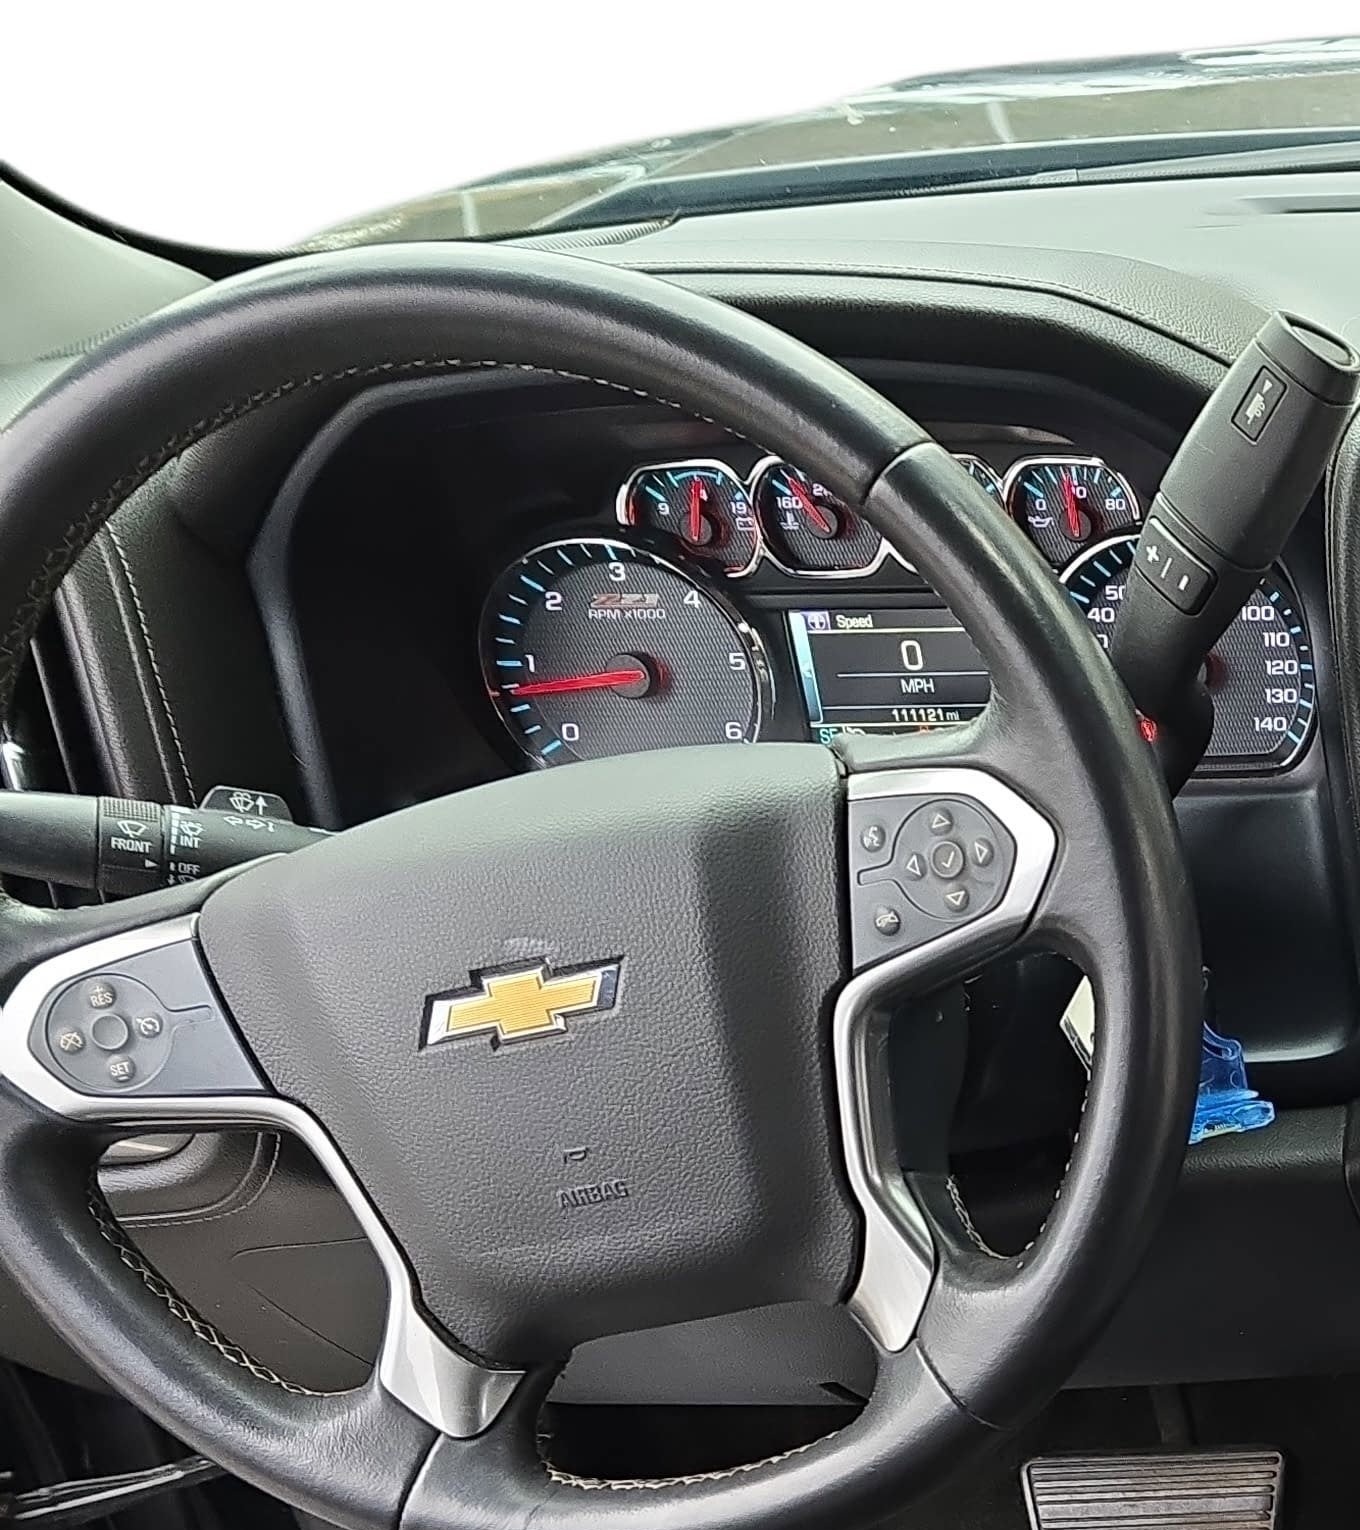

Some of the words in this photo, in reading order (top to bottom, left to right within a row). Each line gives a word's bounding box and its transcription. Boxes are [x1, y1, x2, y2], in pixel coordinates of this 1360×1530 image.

[658, 503, 670, 515] 9
[731, 501, 747, 514] 19
[777, 496, 803, 510] 160
[1035, 498, 1047, 511] 0
[1105, 499, 1126, 511] 80
[609, 562, 626, 582] 3
[545, 591, 562, 611] 2
[683, 590, 701, 609] 4
[588, 608, 621, 620] RPM
[1088, 607, 1115, 623] 40
[1242, 605, 1275, 621] 100
[835, 614, 873, 629] Speed
[1263, 631, 1290, 647] 110
[524, 654, 536, 673] 1
[729, 652, 746, 671] 5
[900, 640, 924, 671] 0
[1266, 660, 1298, 675] 120
[901, 678, 935, 694] MPH
[1266, 688, 1298, 704] 130
[891, 708, 945, 722] 111121
[946, 710, 961, 721] mi
[725, 722, 743, 740] 6
[1254, 716, 1287, 732] 140
[562, 723, 580, 742] 0
[111, 837, 152, 853] FRONT
[180, 835, 200, 849] INT
[178, 862, 200, 875] OFF
[90, 991, 113, 1007] RES
[109, 1062, 130, 1076] SET
[560, 1180, 629, 1208] AIRBAG
